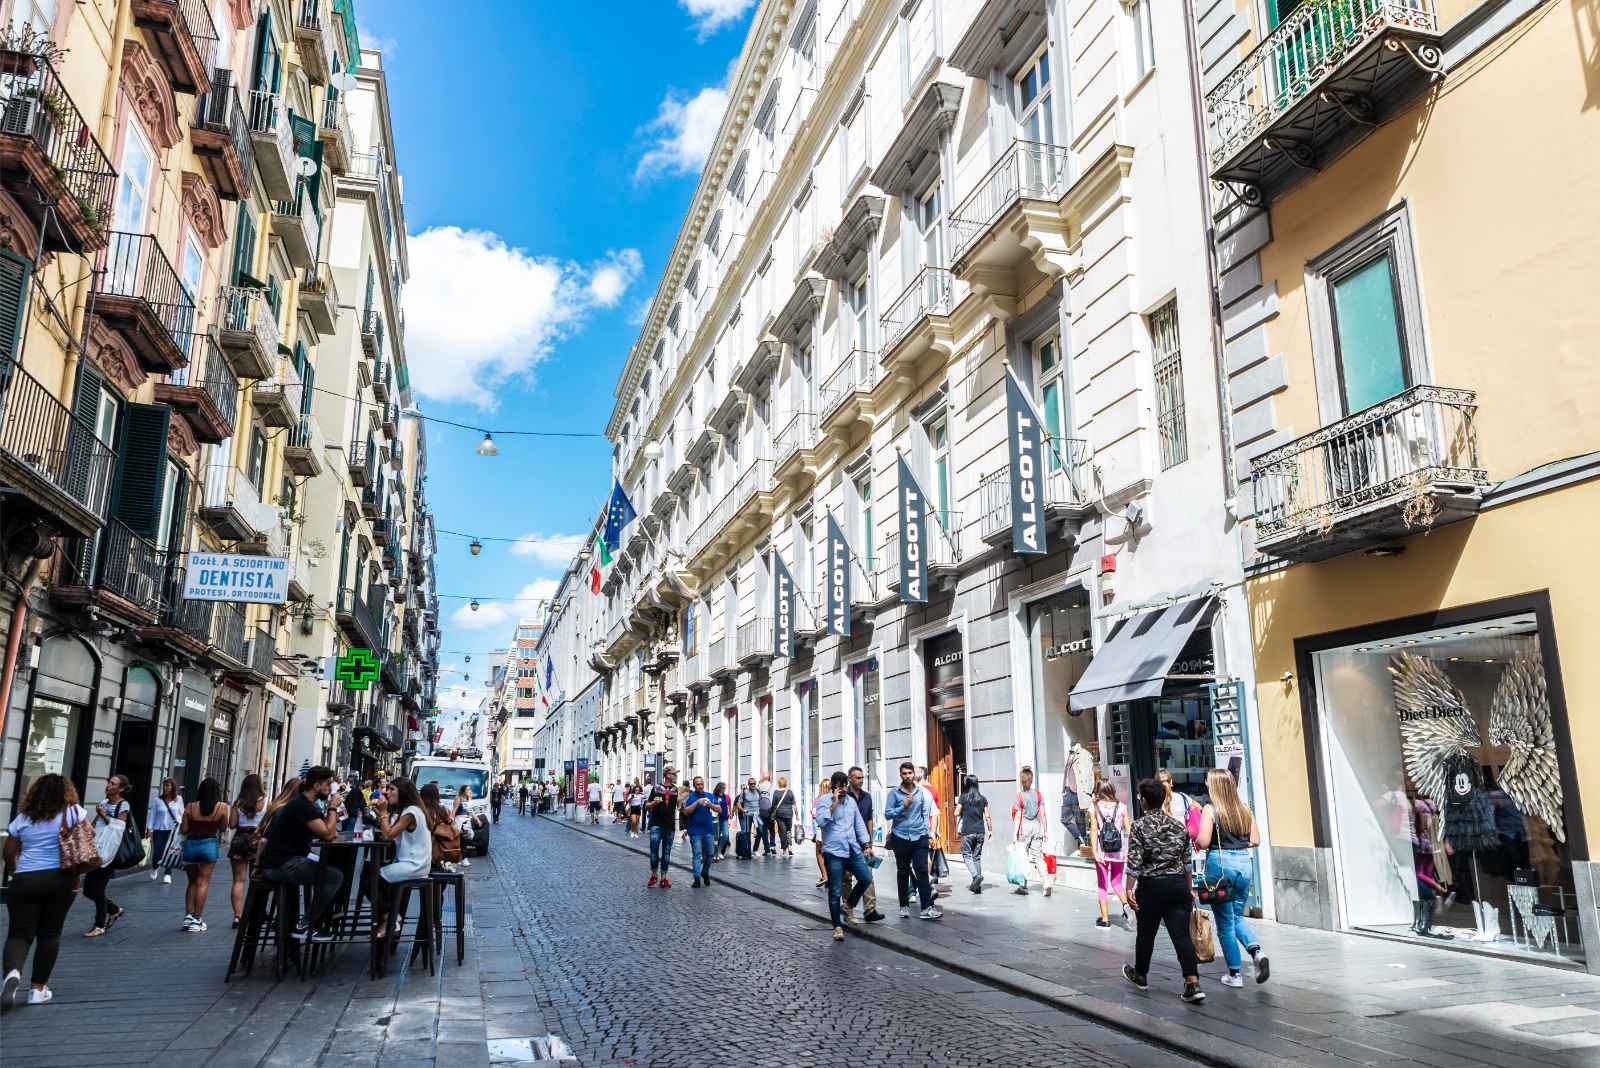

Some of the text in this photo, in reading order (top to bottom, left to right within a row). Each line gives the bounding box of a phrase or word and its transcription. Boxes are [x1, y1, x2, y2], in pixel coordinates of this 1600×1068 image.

[1017, 411, 1038, 550] ALCOTT
[233, 558, 285, 570] SCIORTINO
[905, 488, 921, 600] ALCOTT
[199, 570, 274, 588] DENTISTA
[232, 590, 281, 600] ORTODONZIA
[833, 539, 845, 633] ALCOTT
[779, 574, 789, 656] ALCOTT
[1400, 704, 1464, 721] Dieci Dieci
